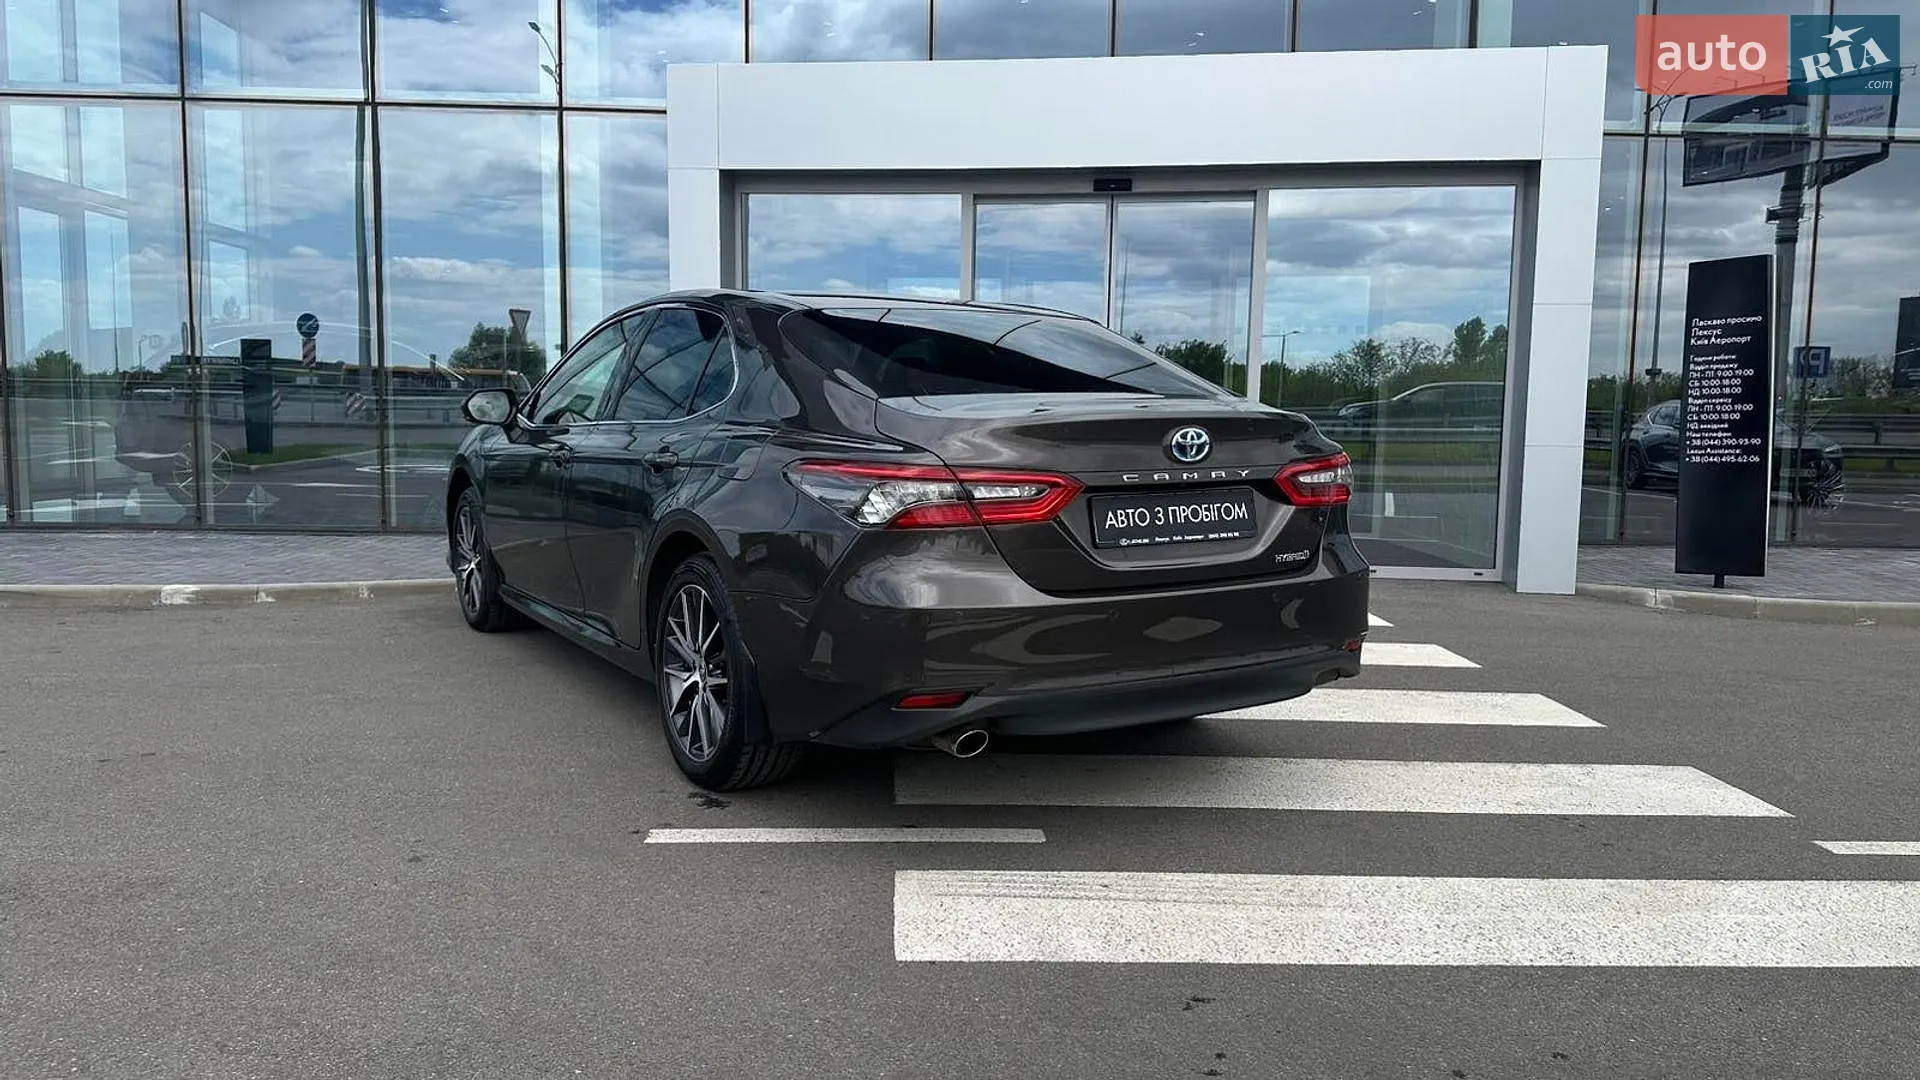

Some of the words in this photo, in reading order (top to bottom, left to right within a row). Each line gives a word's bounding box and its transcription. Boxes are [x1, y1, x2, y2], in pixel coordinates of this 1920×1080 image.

[1710, 336, 1751, 345] Аеропорт
[1122, 470, 1249, 482] CAMRY
[1105, 508, 1150, 529] АВТО
[1168, 502, 1248, 524] ПРОБІГОМ
